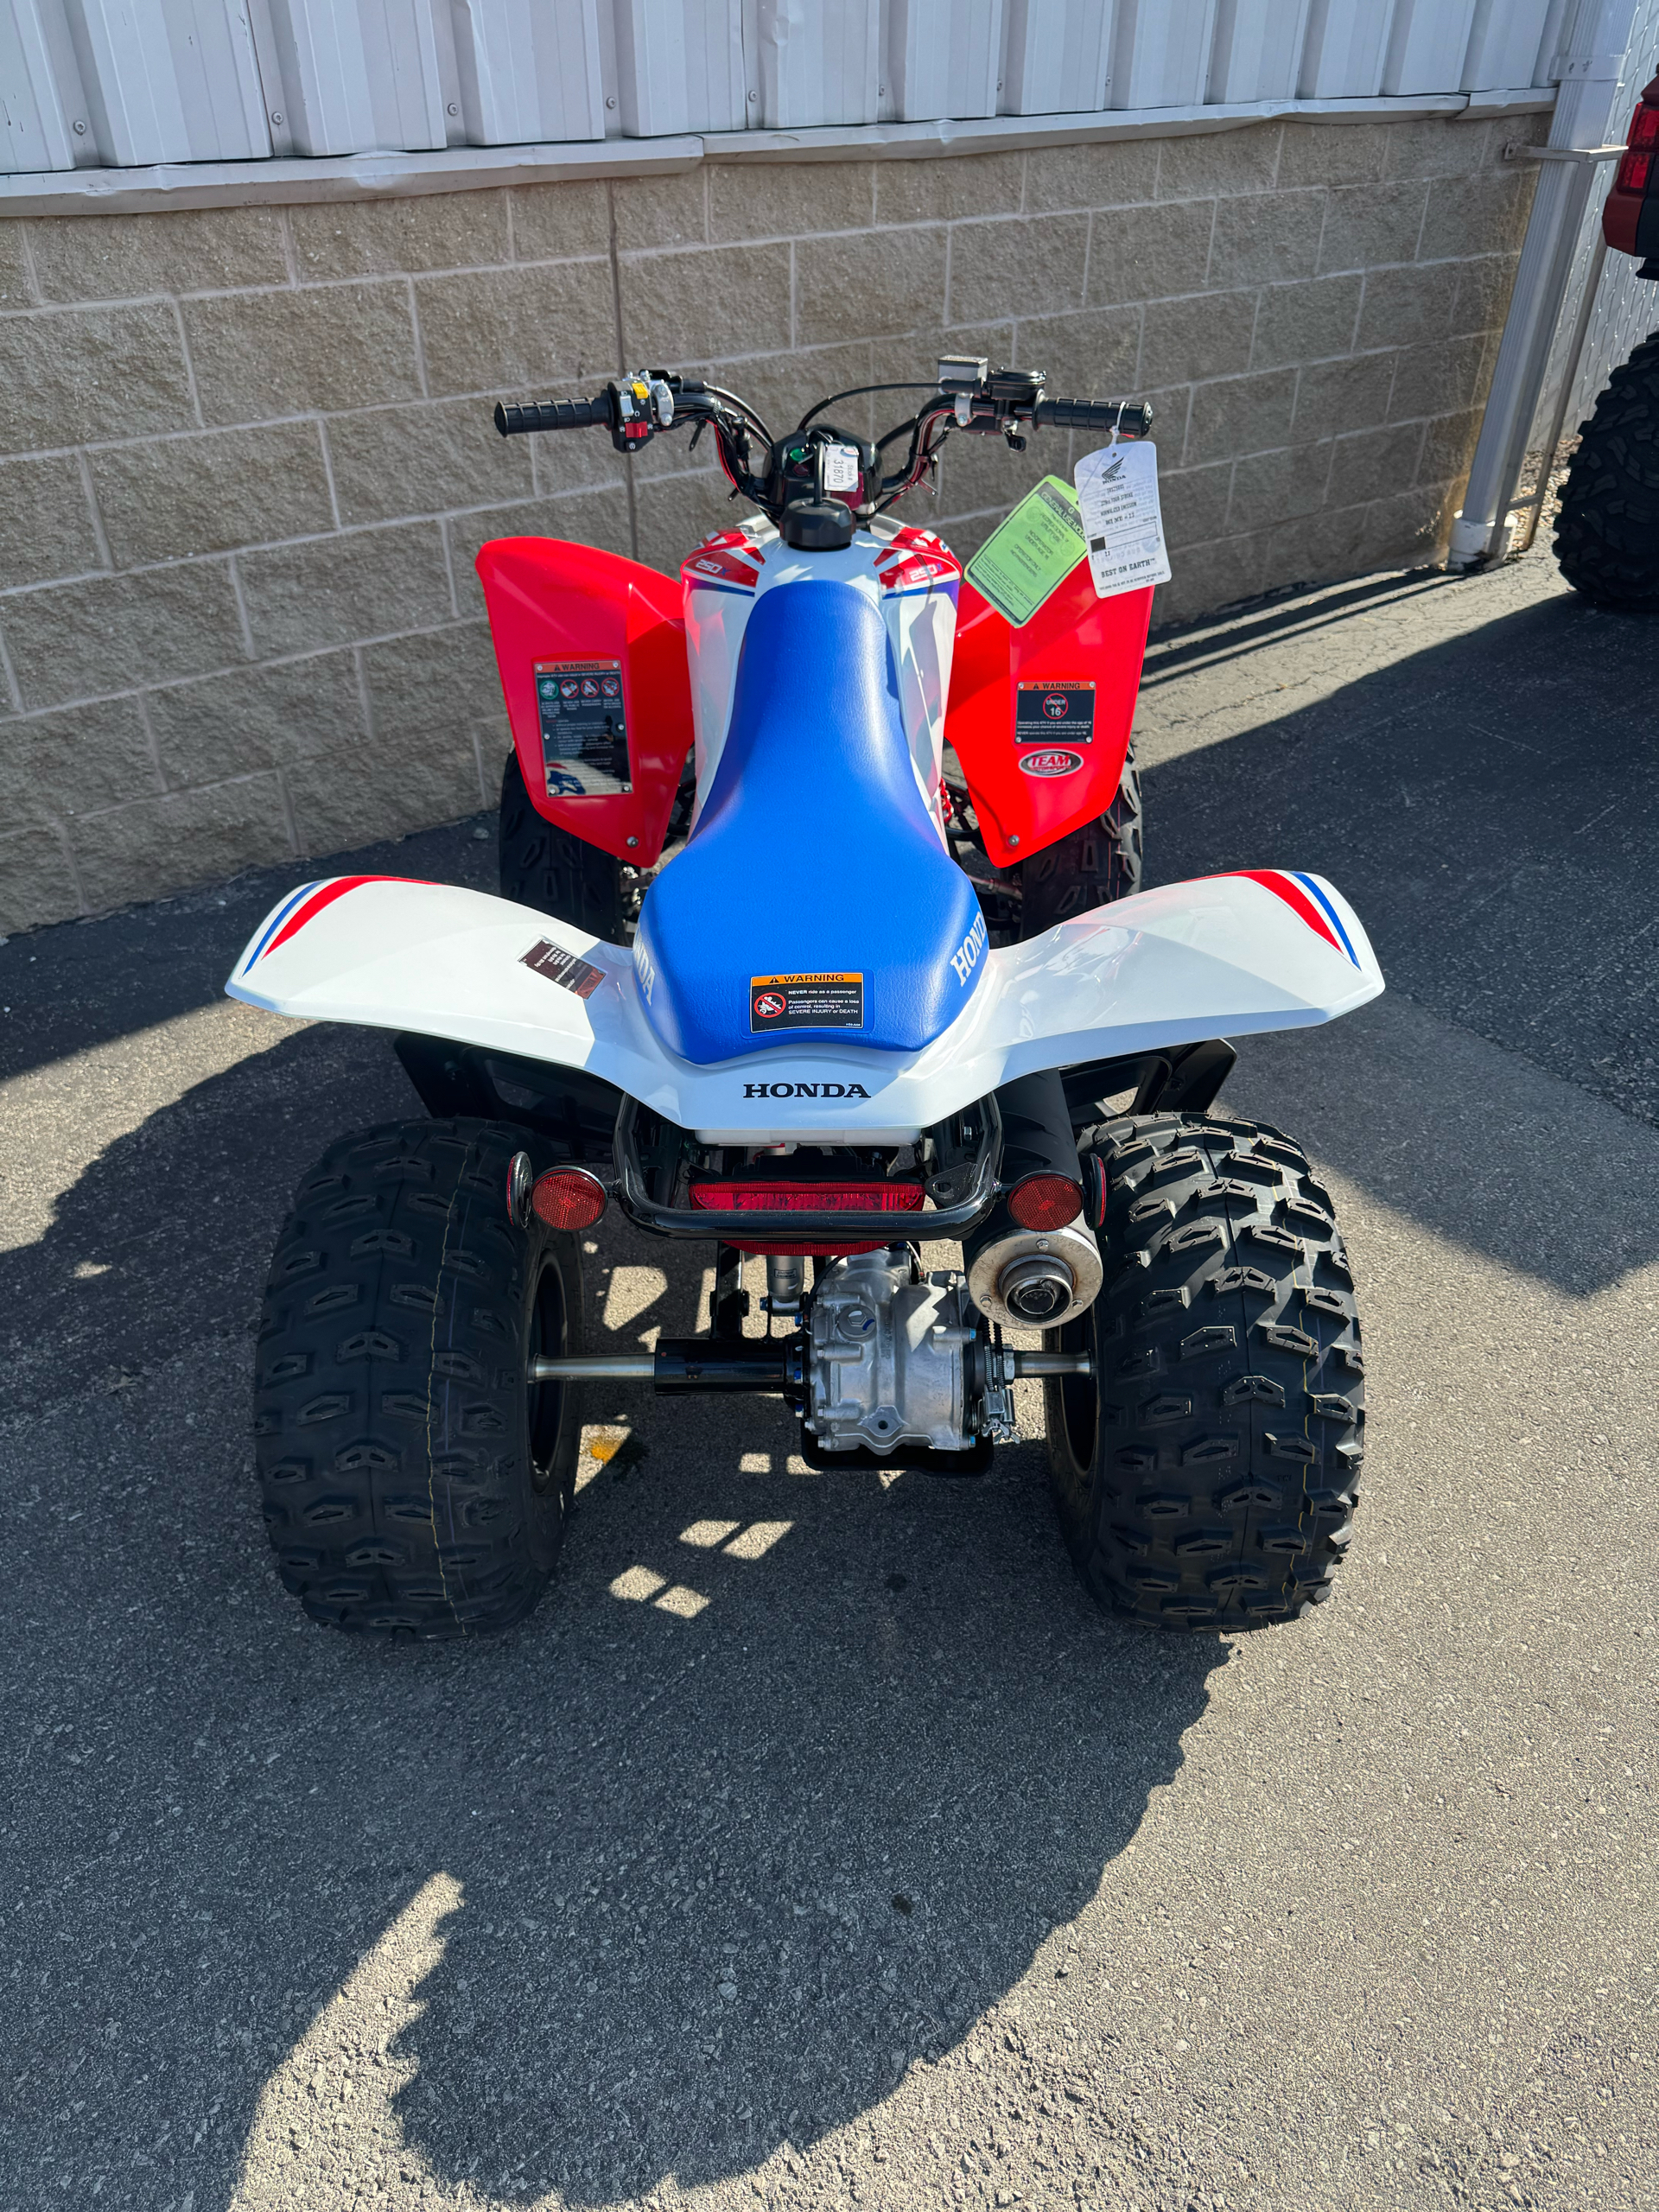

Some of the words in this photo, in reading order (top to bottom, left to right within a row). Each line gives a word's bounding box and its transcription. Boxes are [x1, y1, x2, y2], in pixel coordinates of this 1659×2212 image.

[833, 460, 844, 484] 31870
[1103, 475, 1126, 485] HONDA
[1041, 492, 1064, 516] GENERAL
[1062, 512, 1074, 526] USE
[696, 559, 731, 576] 250X
[909, 563, 944, 582] 250X
[1101, 569, 1116, 578] BEST
[562, 663, 600, 671] WARNING
[1031, 754, 1070, 766] TEAM
[950, 911, 986, 987] HOND
[785, 974, 844, 982] WARNING
[743, 1083, 871, 1098] HONDA
